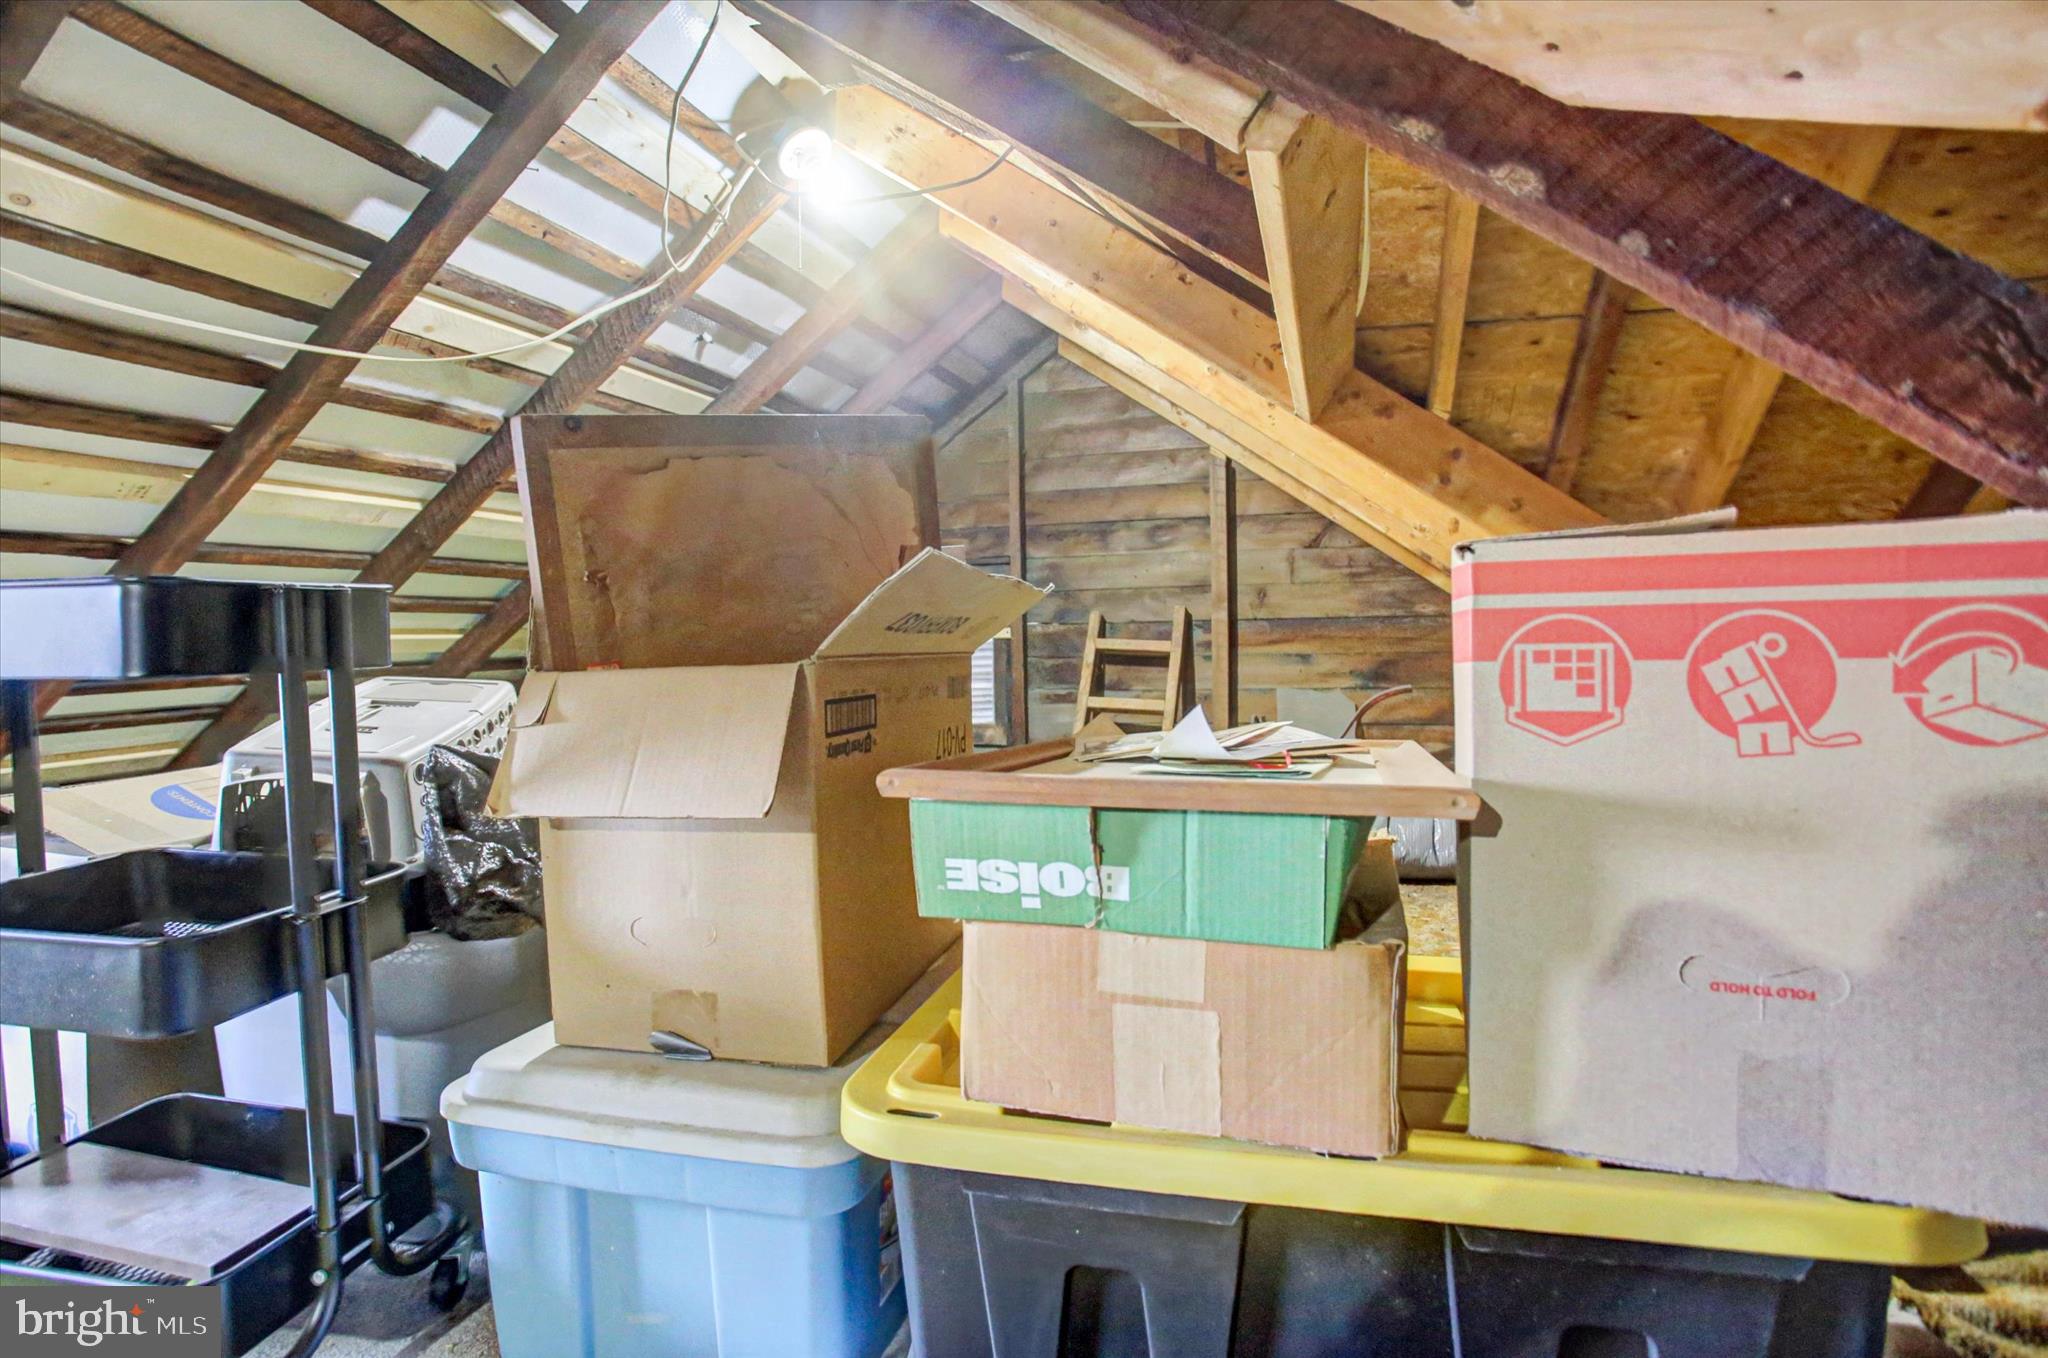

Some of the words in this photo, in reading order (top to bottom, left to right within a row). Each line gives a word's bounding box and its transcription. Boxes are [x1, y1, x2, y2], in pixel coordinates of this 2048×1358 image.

[936, 724, 967, 760] PV-017
[1709, 981, 1750, 995] HOLD
[1753, 984, 1773, 998] TO
[1776, 987, 1817, 1001] FOLD
